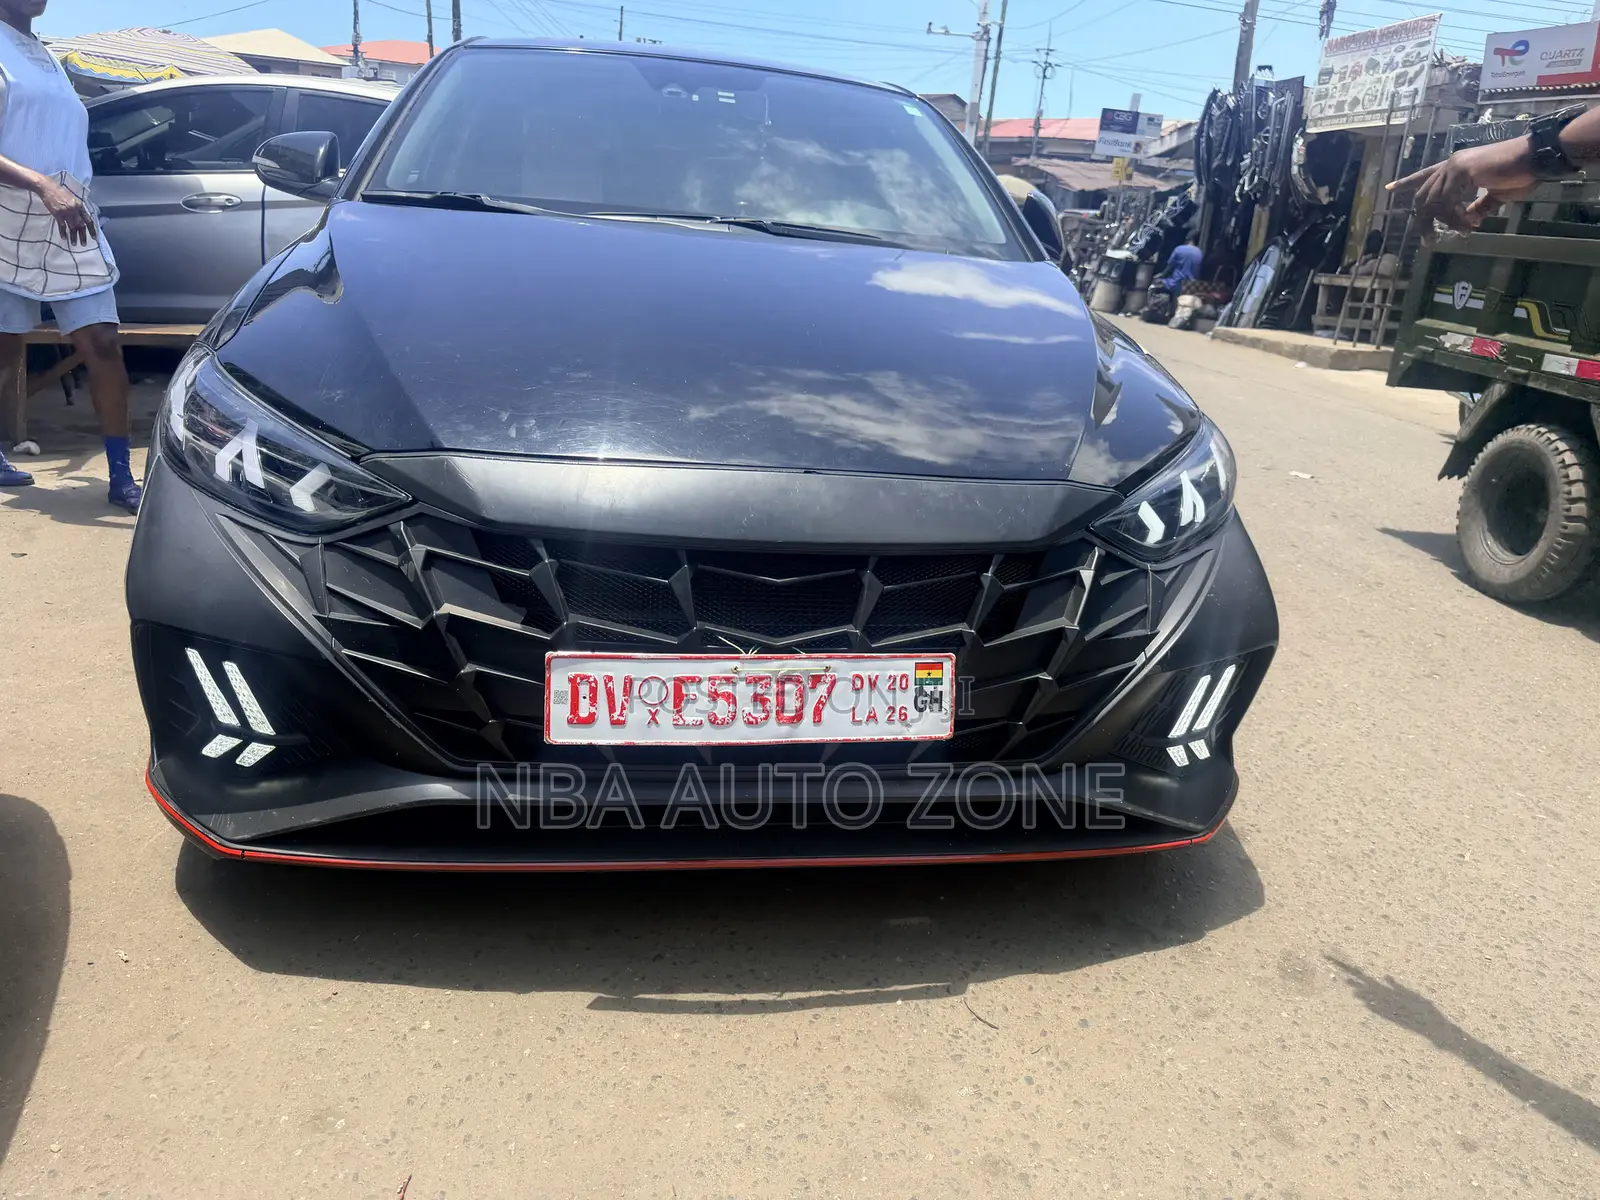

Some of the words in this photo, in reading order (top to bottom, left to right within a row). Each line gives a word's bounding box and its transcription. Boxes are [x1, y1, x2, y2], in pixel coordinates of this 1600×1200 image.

[1540, 48, 1585, 60] QUARTZ
[887, 673, 909, 691] 20
[567, 672, 633, 725] DV
[914, 687, 944, 713] GH
[851, 706, 879, 723] LA
[886, 706, 909, 723] 26
